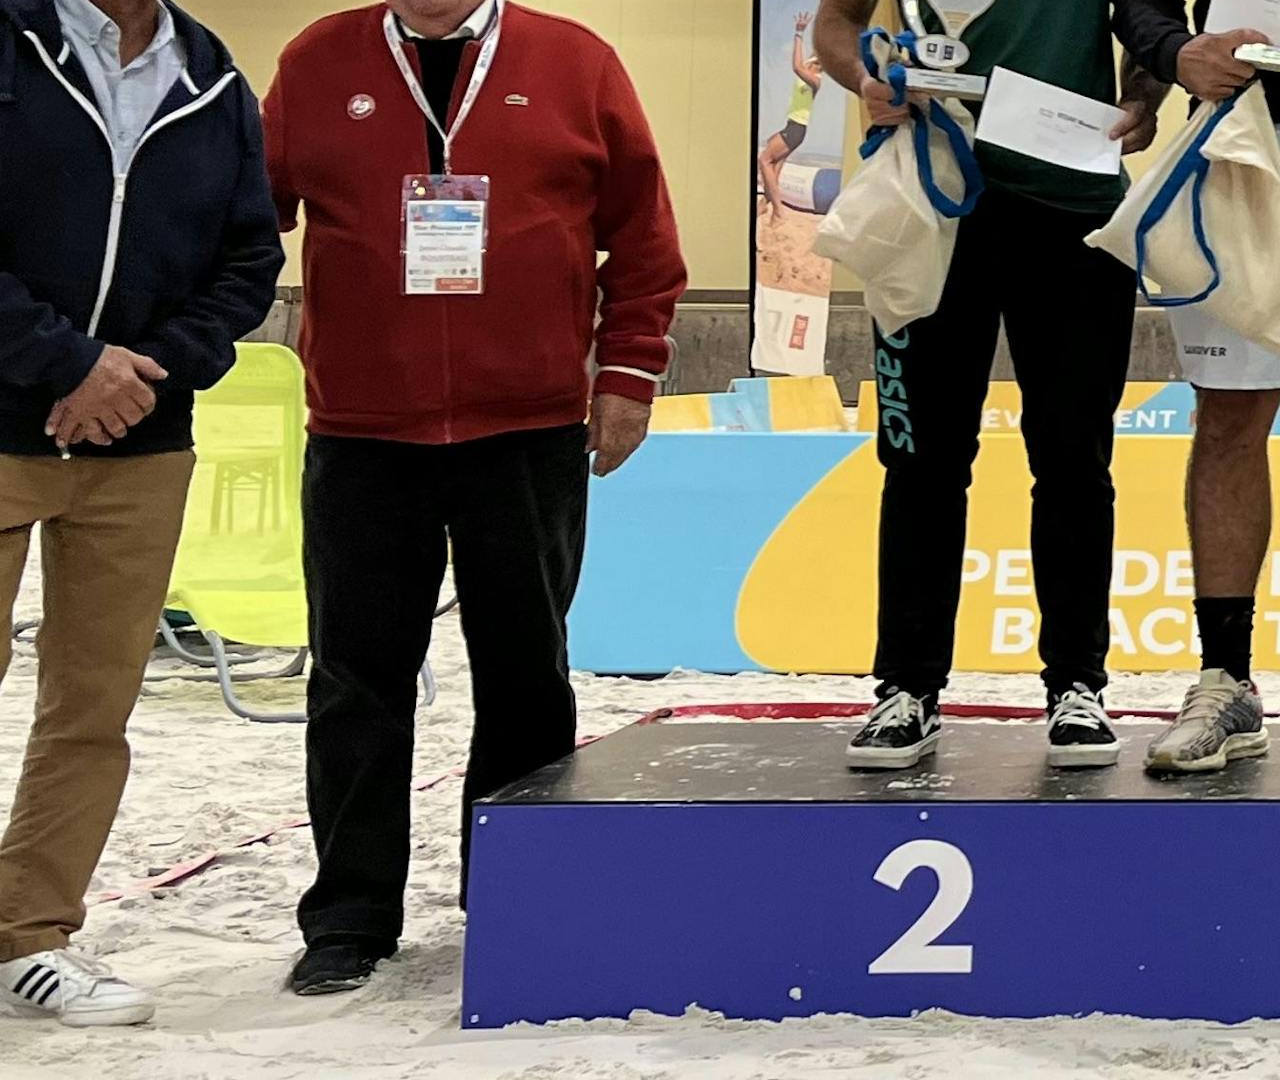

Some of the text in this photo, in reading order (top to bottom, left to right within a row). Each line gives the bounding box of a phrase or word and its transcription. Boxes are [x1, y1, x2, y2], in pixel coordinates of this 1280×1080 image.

[877, 348, 916, 454] asics
[1111, 549, 1195, 596] DE
[868, 839, 973, 974] 2
